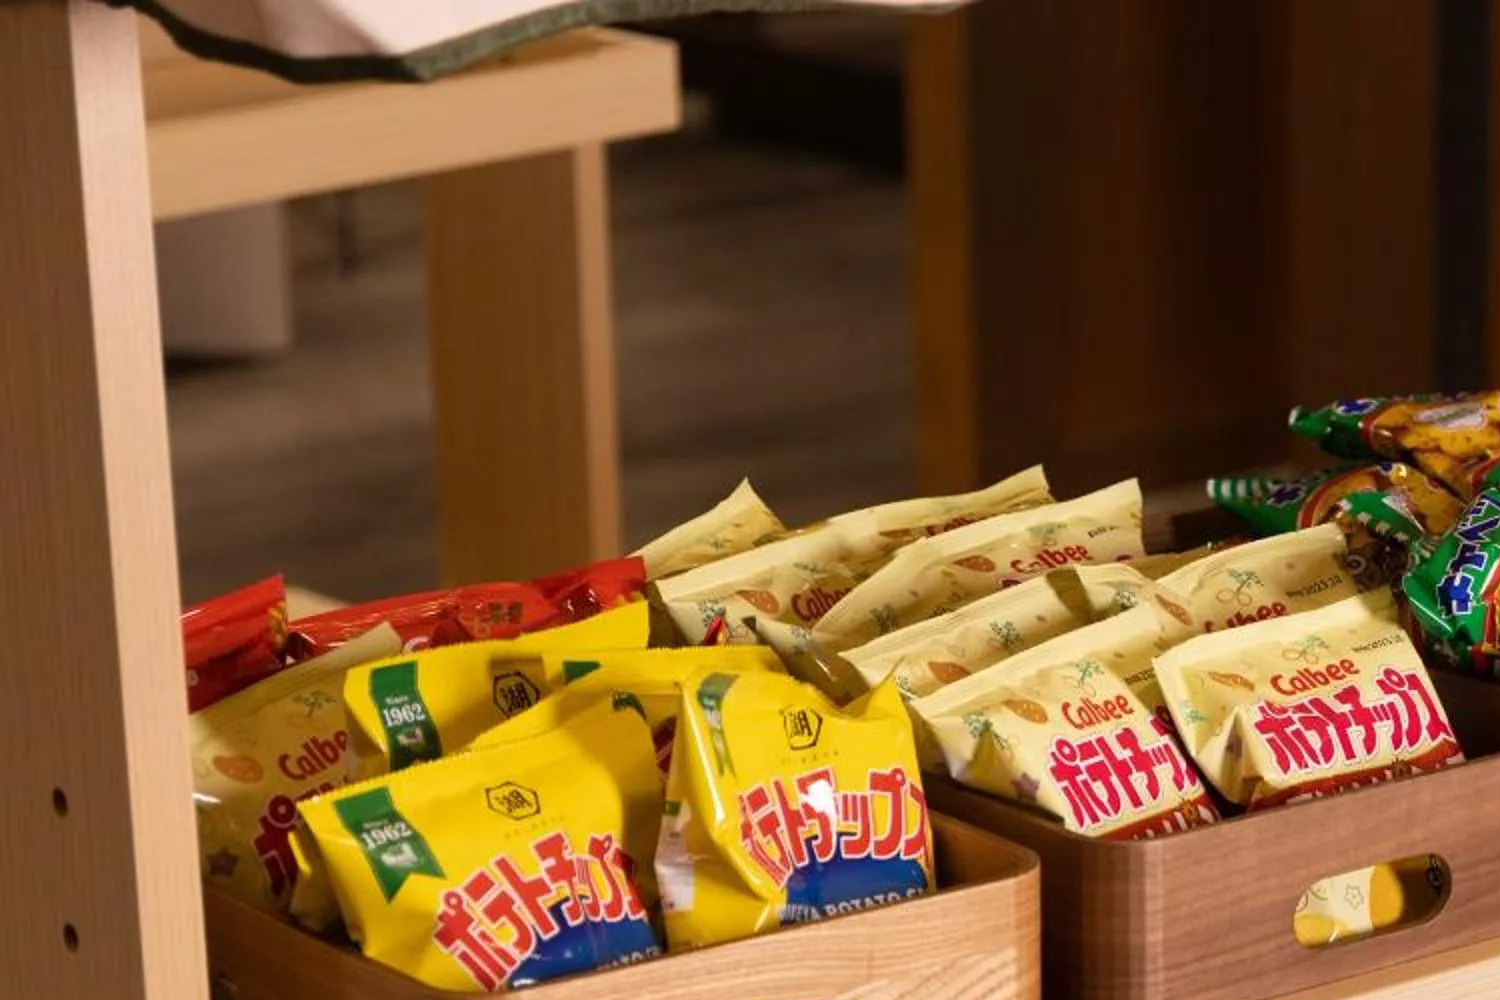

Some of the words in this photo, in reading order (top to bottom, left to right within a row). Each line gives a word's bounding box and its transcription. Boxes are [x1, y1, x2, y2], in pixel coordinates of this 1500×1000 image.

[1269, 658, 1361, 697] Calbee
[382, 702, 427, 728] 1962
[1061, 694, 1135, 731] Calbee
[277, 729, 349, 781] Calbe
[360, 820, 413, 851] 1962
